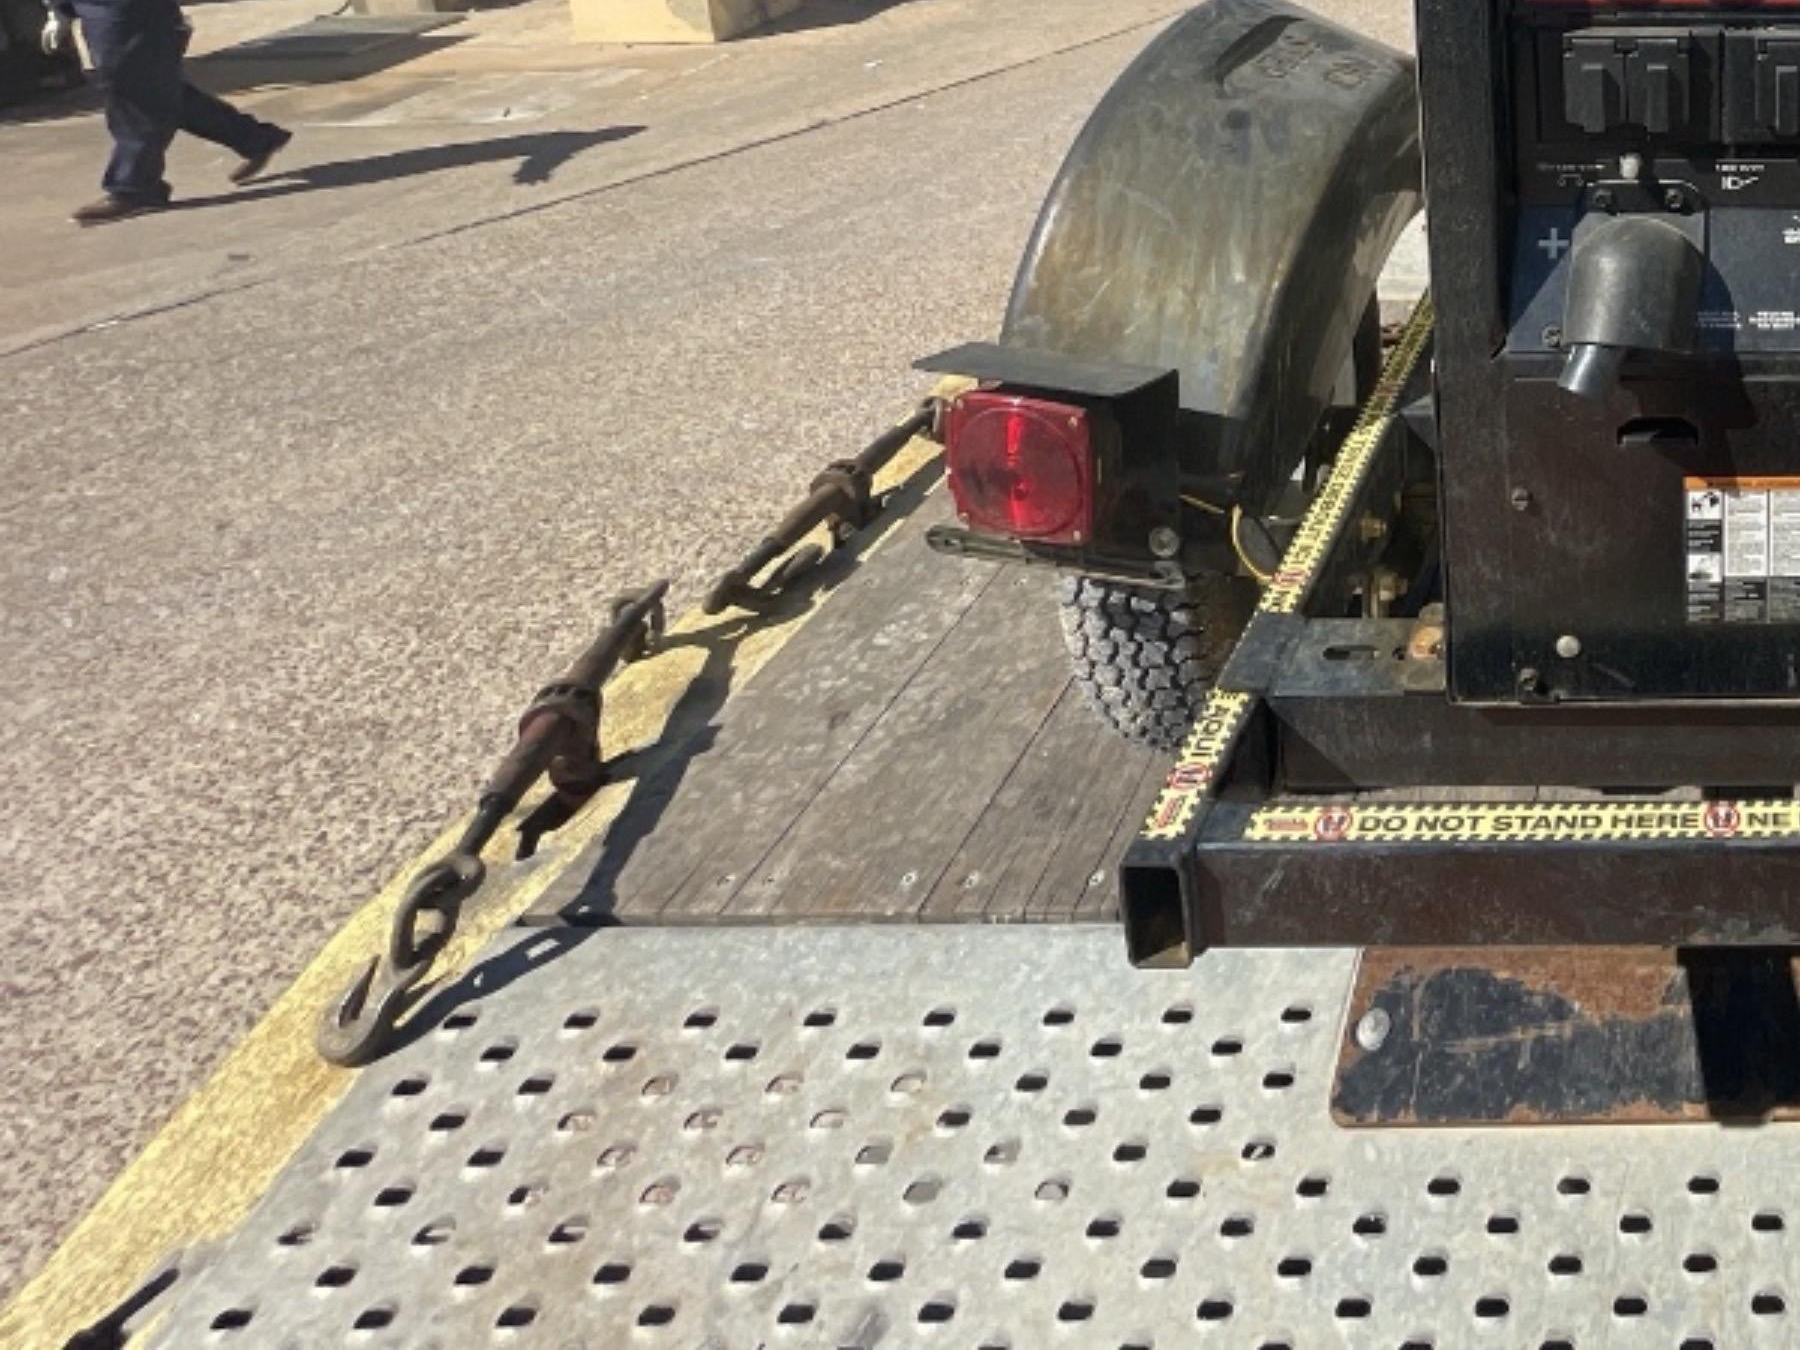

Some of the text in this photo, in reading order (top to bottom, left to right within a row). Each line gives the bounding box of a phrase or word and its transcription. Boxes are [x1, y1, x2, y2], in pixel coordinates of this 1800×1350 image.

[1358, 812, 1701, 833] DO NOT STAND HERE
[1747, 812, 1792, 827] NE
